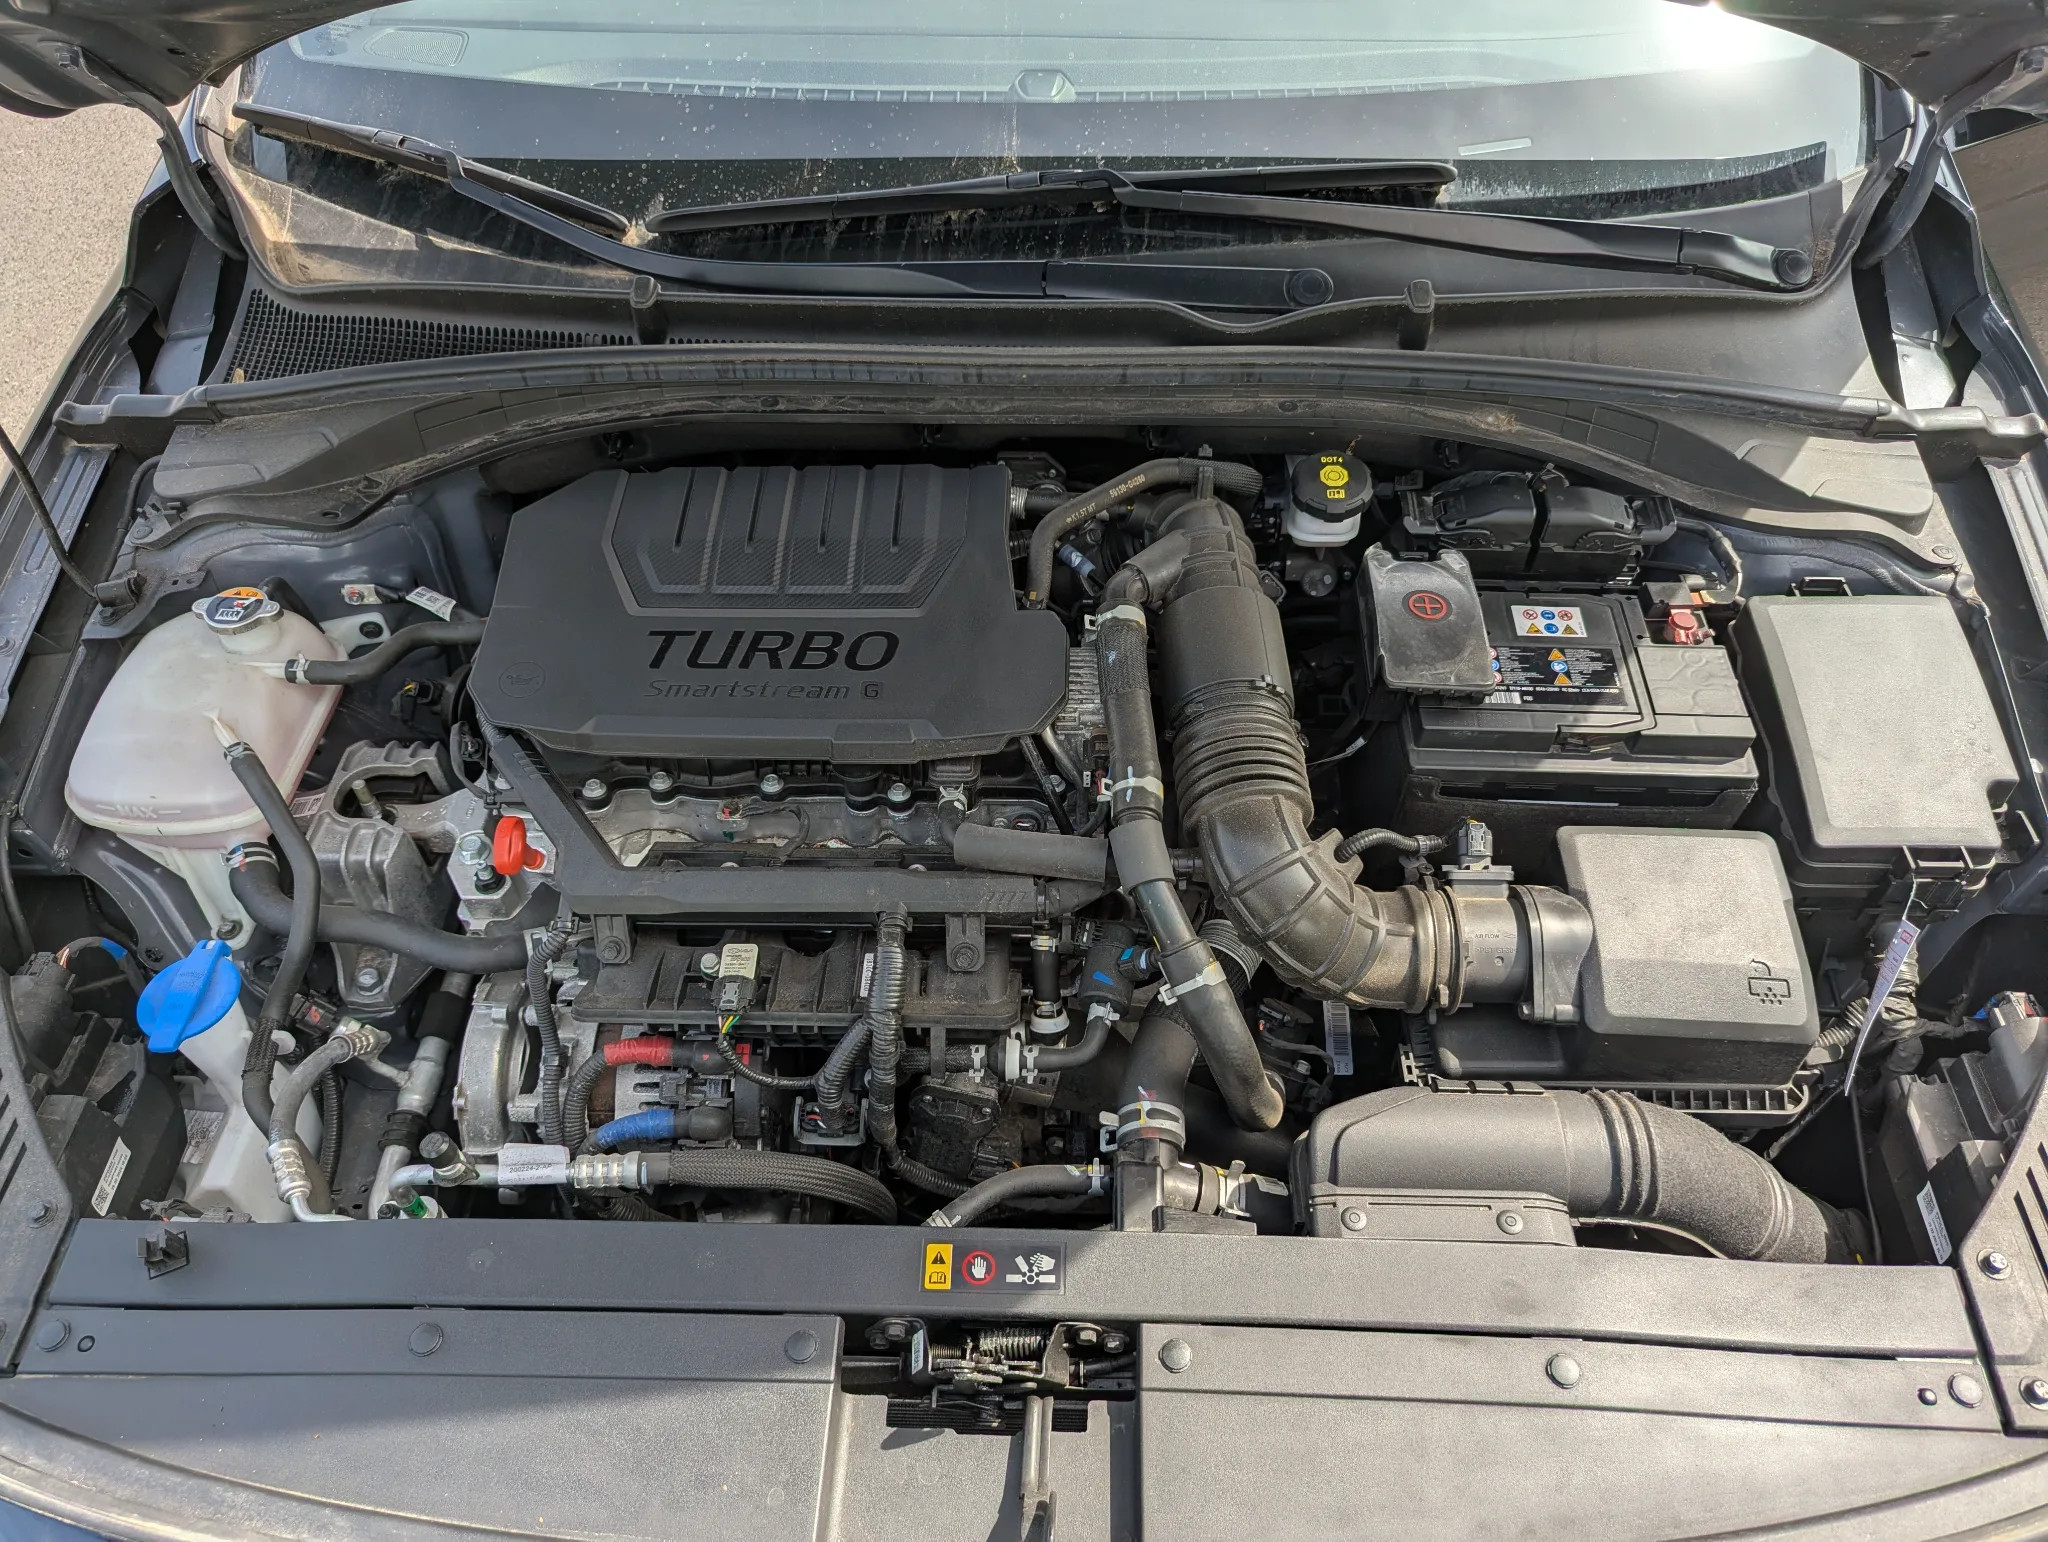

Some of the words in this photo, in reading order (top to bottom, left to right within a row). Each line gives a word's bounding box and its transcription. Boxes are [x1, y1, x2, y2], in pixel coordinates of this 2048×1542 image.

[647, 629, 900, 672] TURBO
[644, 679, 850, 699] Smartstream
[863, 683, 880, 698] G
